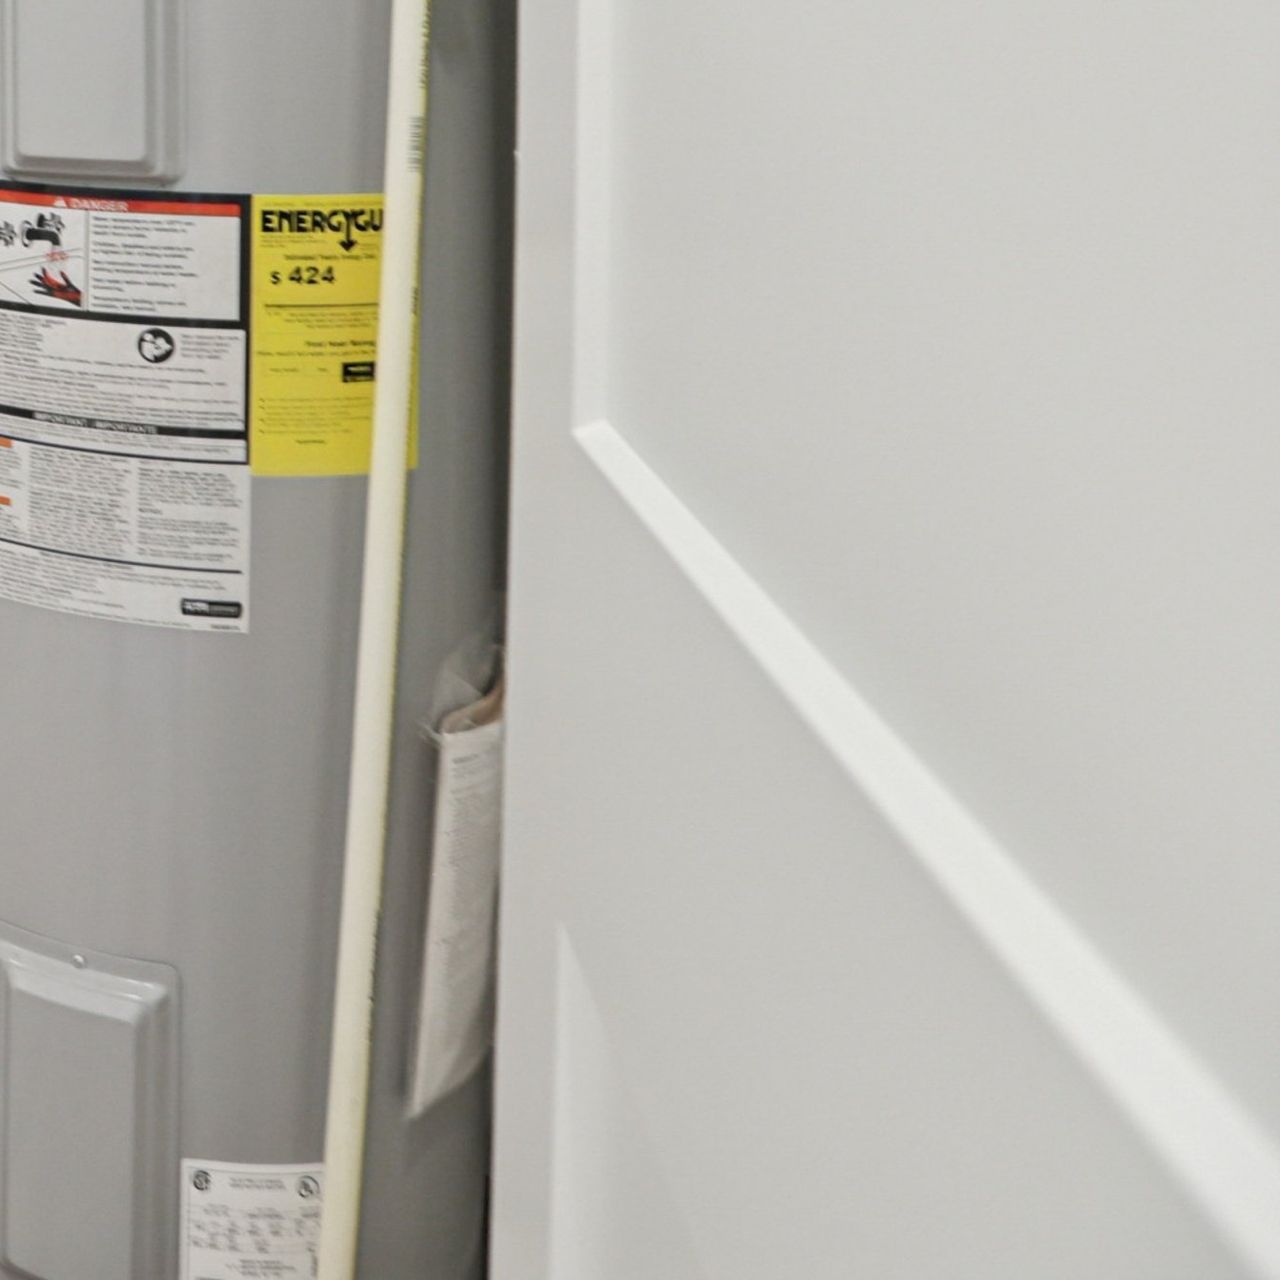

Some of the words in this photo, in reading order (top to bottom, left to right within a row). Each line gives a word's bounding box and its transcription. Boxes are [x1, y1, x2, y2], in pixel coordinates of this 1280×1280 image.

[69, 198, 128, 213] DANGER
[270, 271, 281, 285] $
[288, 266, 335, 285] 424
